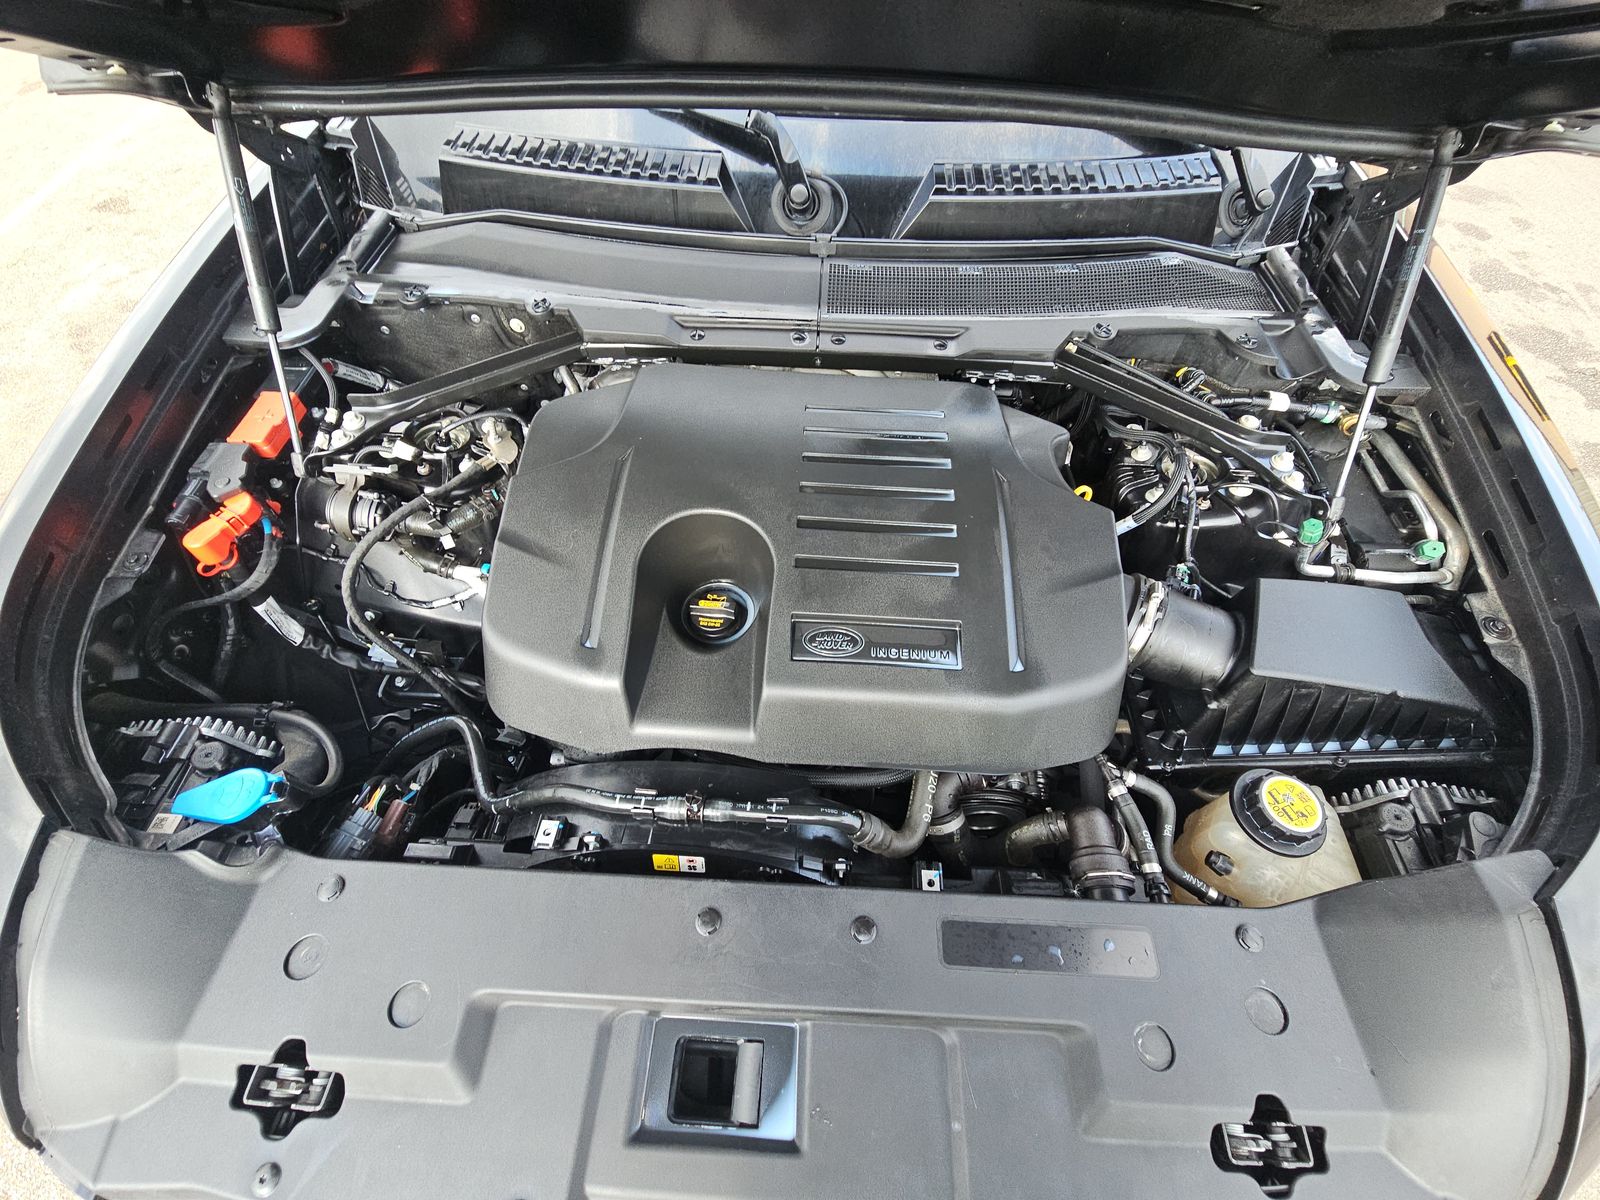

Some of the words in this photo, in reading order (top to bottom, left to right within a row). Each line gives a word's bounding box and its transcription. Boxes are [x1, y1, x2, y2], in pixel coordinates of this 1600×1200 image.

[816, 640, 854, 650] ROVER
[870, 646, 951, 660] INGENIUM
[1182, 871, 1208, 893] TANK
